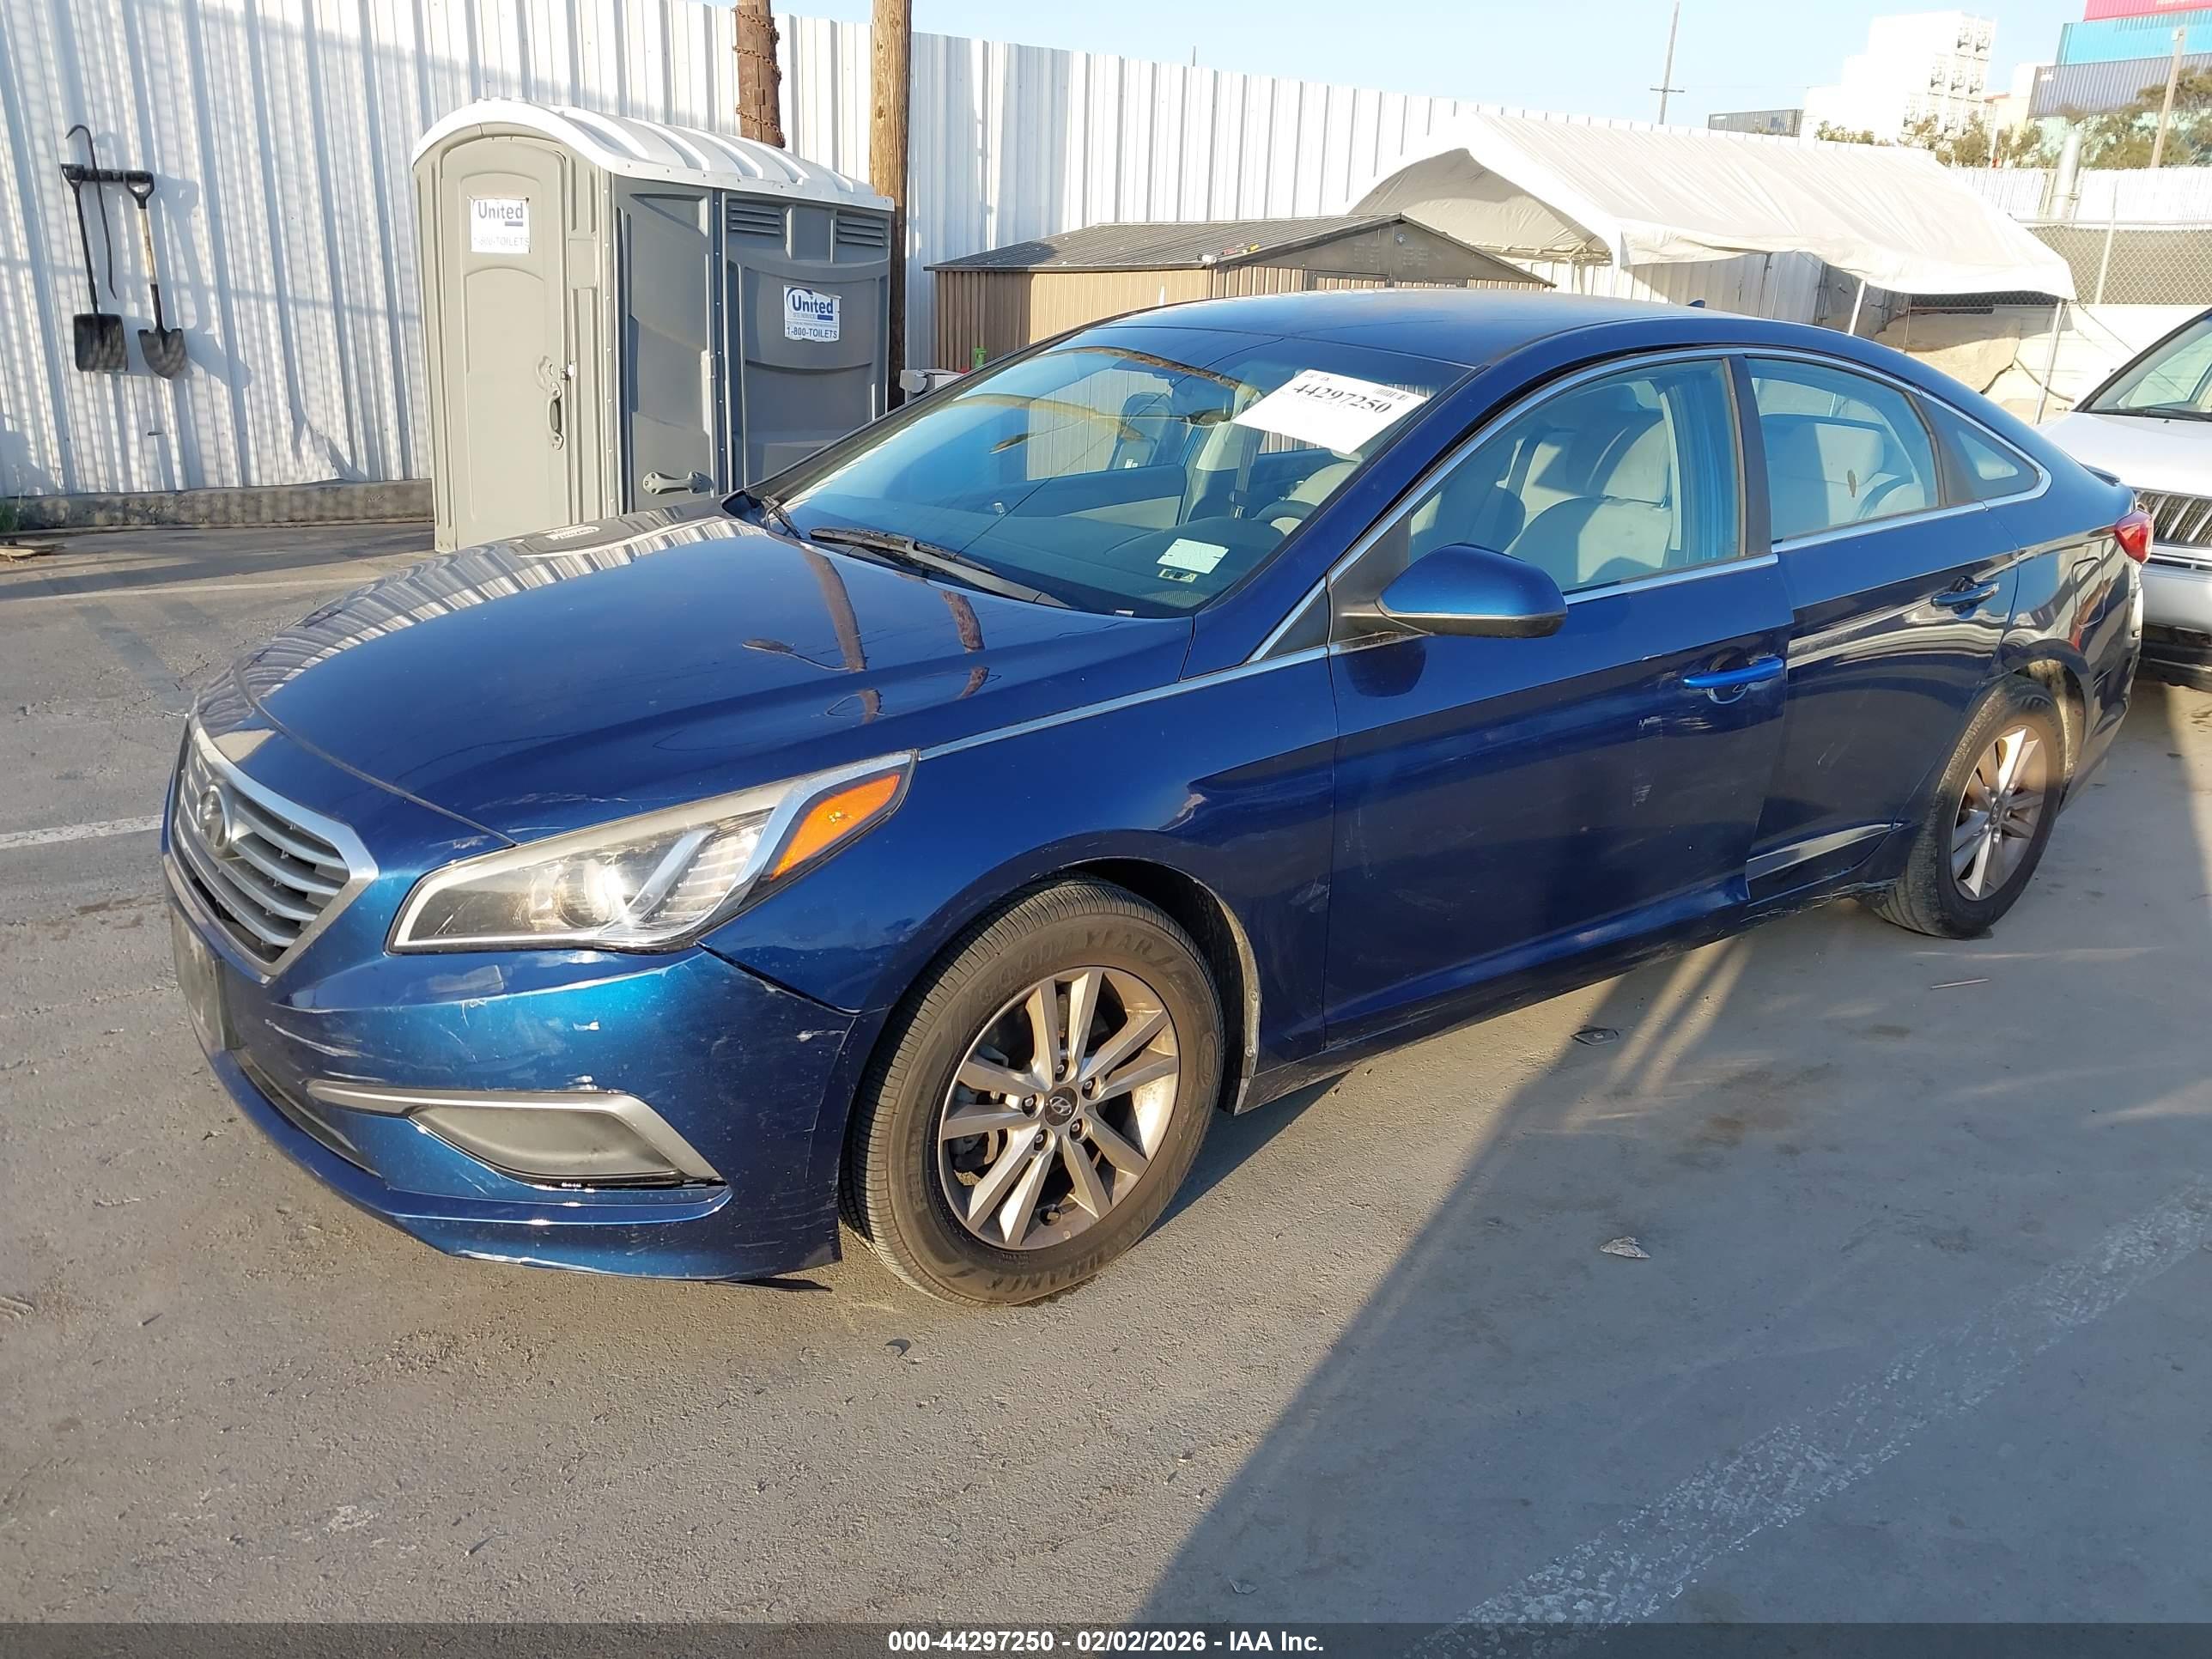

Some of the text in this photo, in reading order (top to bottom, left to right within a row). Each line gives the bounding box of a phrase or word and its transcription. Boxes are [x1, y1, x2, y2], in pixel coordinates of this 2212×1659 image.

[477, 201, 523, 220] United
[792, 294, 833, 314] United
[787, 326, 838, 338] 1-800-TOILETS
[1294, 383, 1392, 413] 44297250
